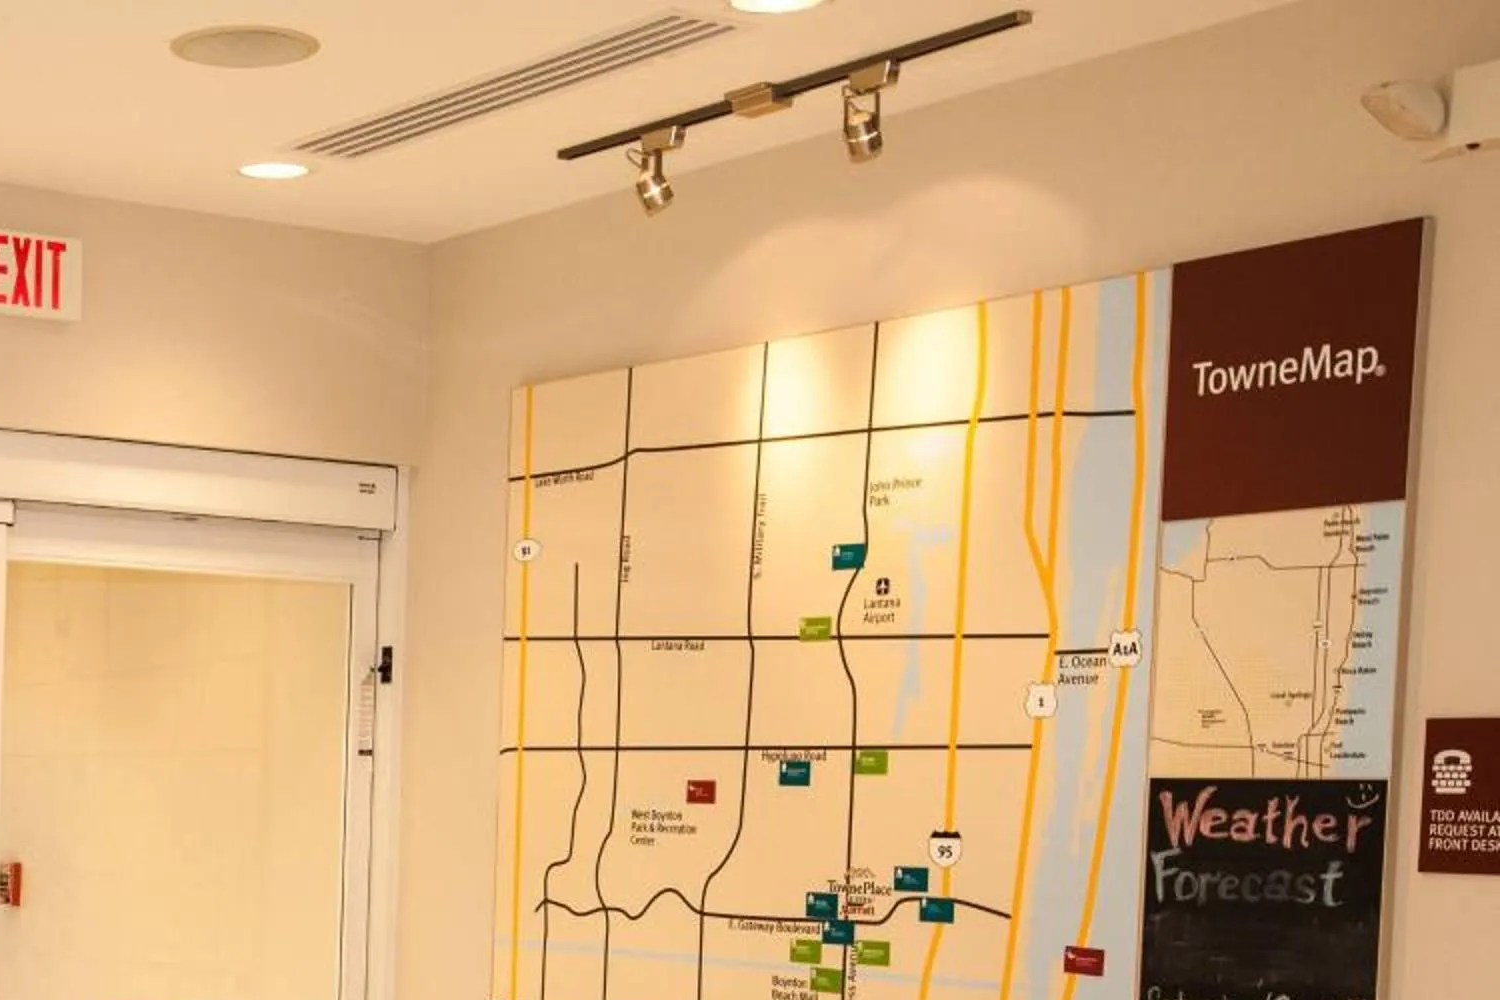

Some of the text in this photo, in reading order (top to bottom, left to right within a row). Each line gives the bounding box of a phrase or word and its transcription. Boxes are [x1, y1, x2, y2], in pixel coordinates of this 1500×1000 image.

[1192, 343, 1379, 396] TowneMap
[869, 495, 890, 507] Park
[863, 597, 901, 609] Lantana
[863, 611, 895, 624] Airport
[685, 639, 705, 651] Road
[1071, 655, 1107, 669] Ocean
[1057, 673, 1099, 685] Avenue
[804, 750, 827, 761] Road
[1160, 786, 1372, 853] Weather
[1429, 823, 1485, 837] REQUEST
[1428, 837, 1468, 850] FRONT
[937, 845, 953, 859] 95
[1151, 846, 1344, 907] Forecast
